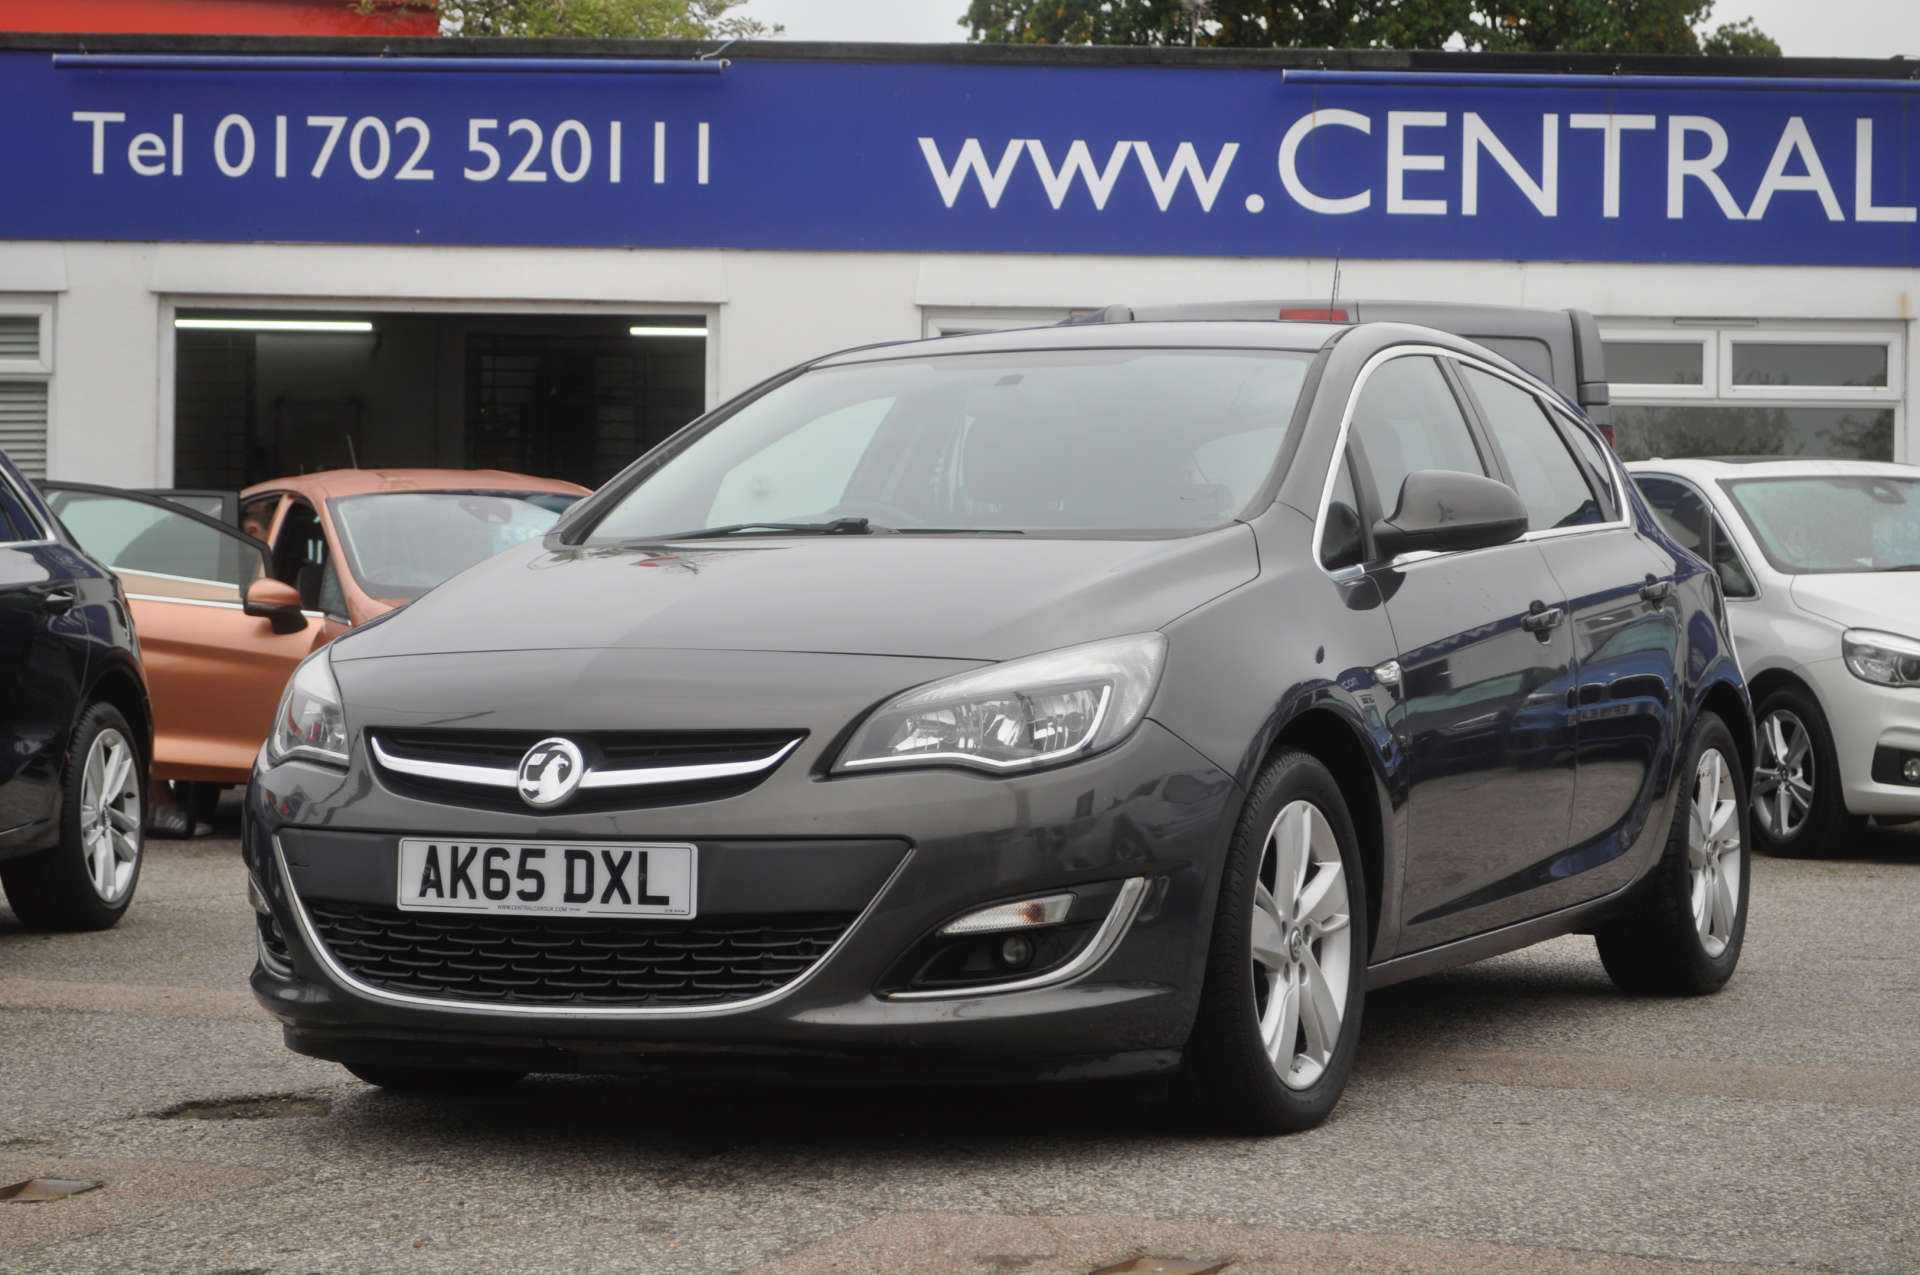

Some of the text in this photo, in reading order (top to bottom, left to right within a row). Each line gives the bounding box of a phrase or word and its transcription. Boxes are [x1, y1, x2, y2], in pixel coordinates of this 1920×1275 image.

[72, 111, 711, 185] Tel 01702 520111
[917, 107, 1918, 223] www.CENTRAL
[418, 844, 670, 906] AK65 DXL
